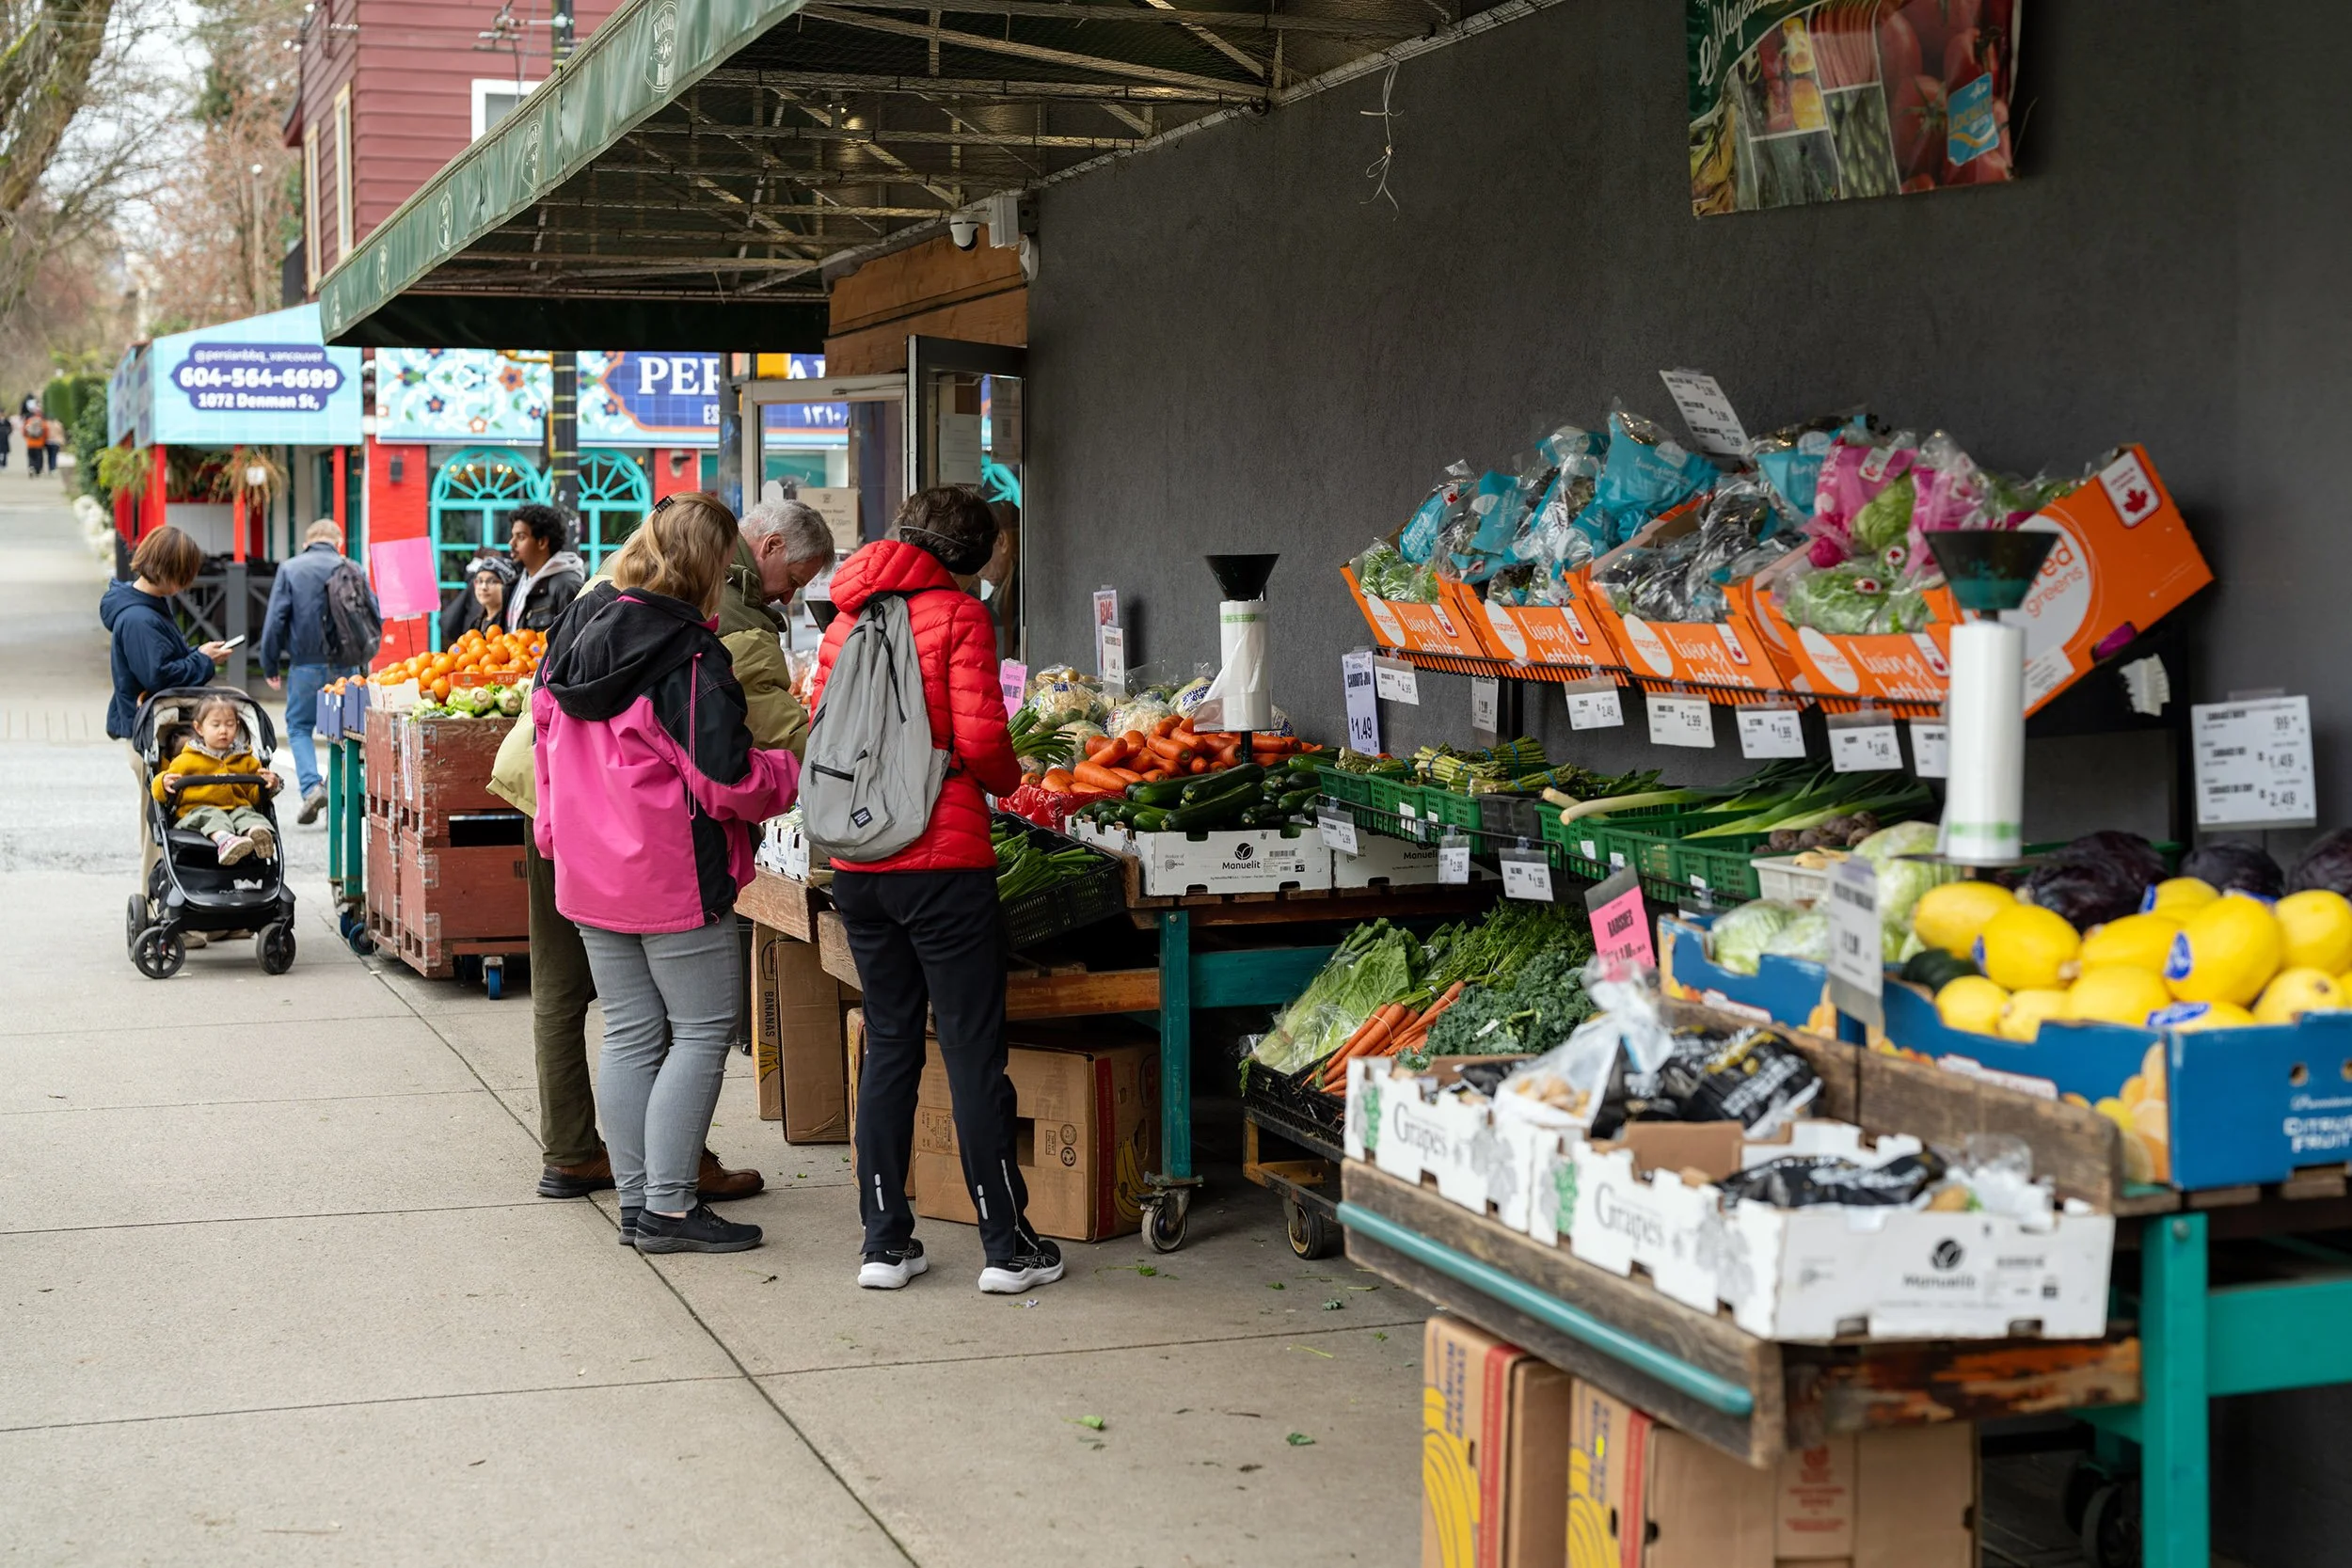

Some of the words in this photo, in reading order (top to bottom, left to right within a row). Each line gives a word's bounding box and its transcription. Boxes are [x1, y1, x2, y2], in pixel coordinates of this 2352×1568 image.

[180, 366, 338, 388] 604-564-6699
[198, 392, 235, 408] 1072
[236, 392, 297, 408] Denman
[2025, 564, 2085, 620] greens
[1395, 605, 1451, 645] living
[1518, 610, 1580, 655] living
[1413, 634, 1465, 656] lettuce
[1537, 643, 1595, 665] lettuce
[1663, 627, 1735, 676] living
[1686, 662, 1756, 688] lettuce
[1847, 641, 1939, 691] living
[1875, 676, 1949, 702] lettuc
[1351, 716, 1373, 740] $1.49
[1222, 860, 1262, 870] Manuelit
[1403, 851, 1438, 860] Manueli
[764, 990, 775, 1037] BANANAS
[1393, 1101, 1449, 1163] Grapes
[2282, 1116, 2352, 1137] CITRU
[1594, 1181, 1665, 1253] Grapes
